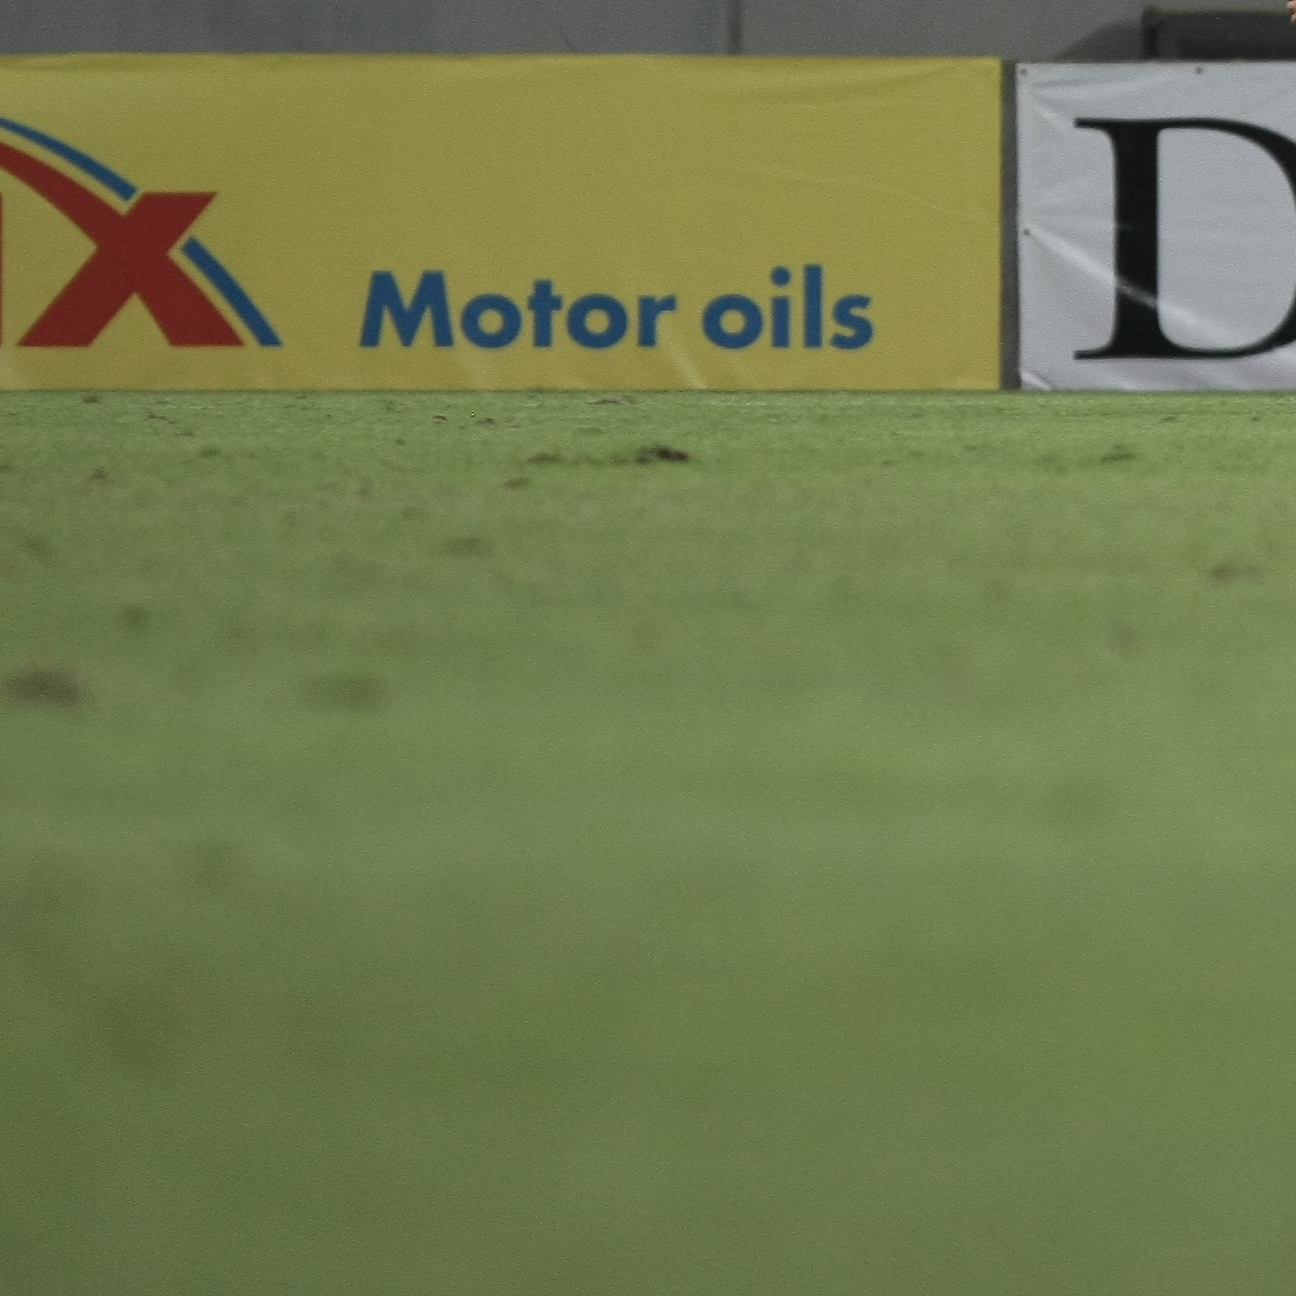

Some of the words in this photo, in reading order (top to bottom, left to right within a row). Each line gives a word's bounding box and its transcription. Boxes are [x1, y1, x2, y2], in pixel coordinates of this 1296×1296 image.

[0, 140, 246, 347] X
[358, 270, 677, 349] Motor
[701, 264, 874, 349] oils
